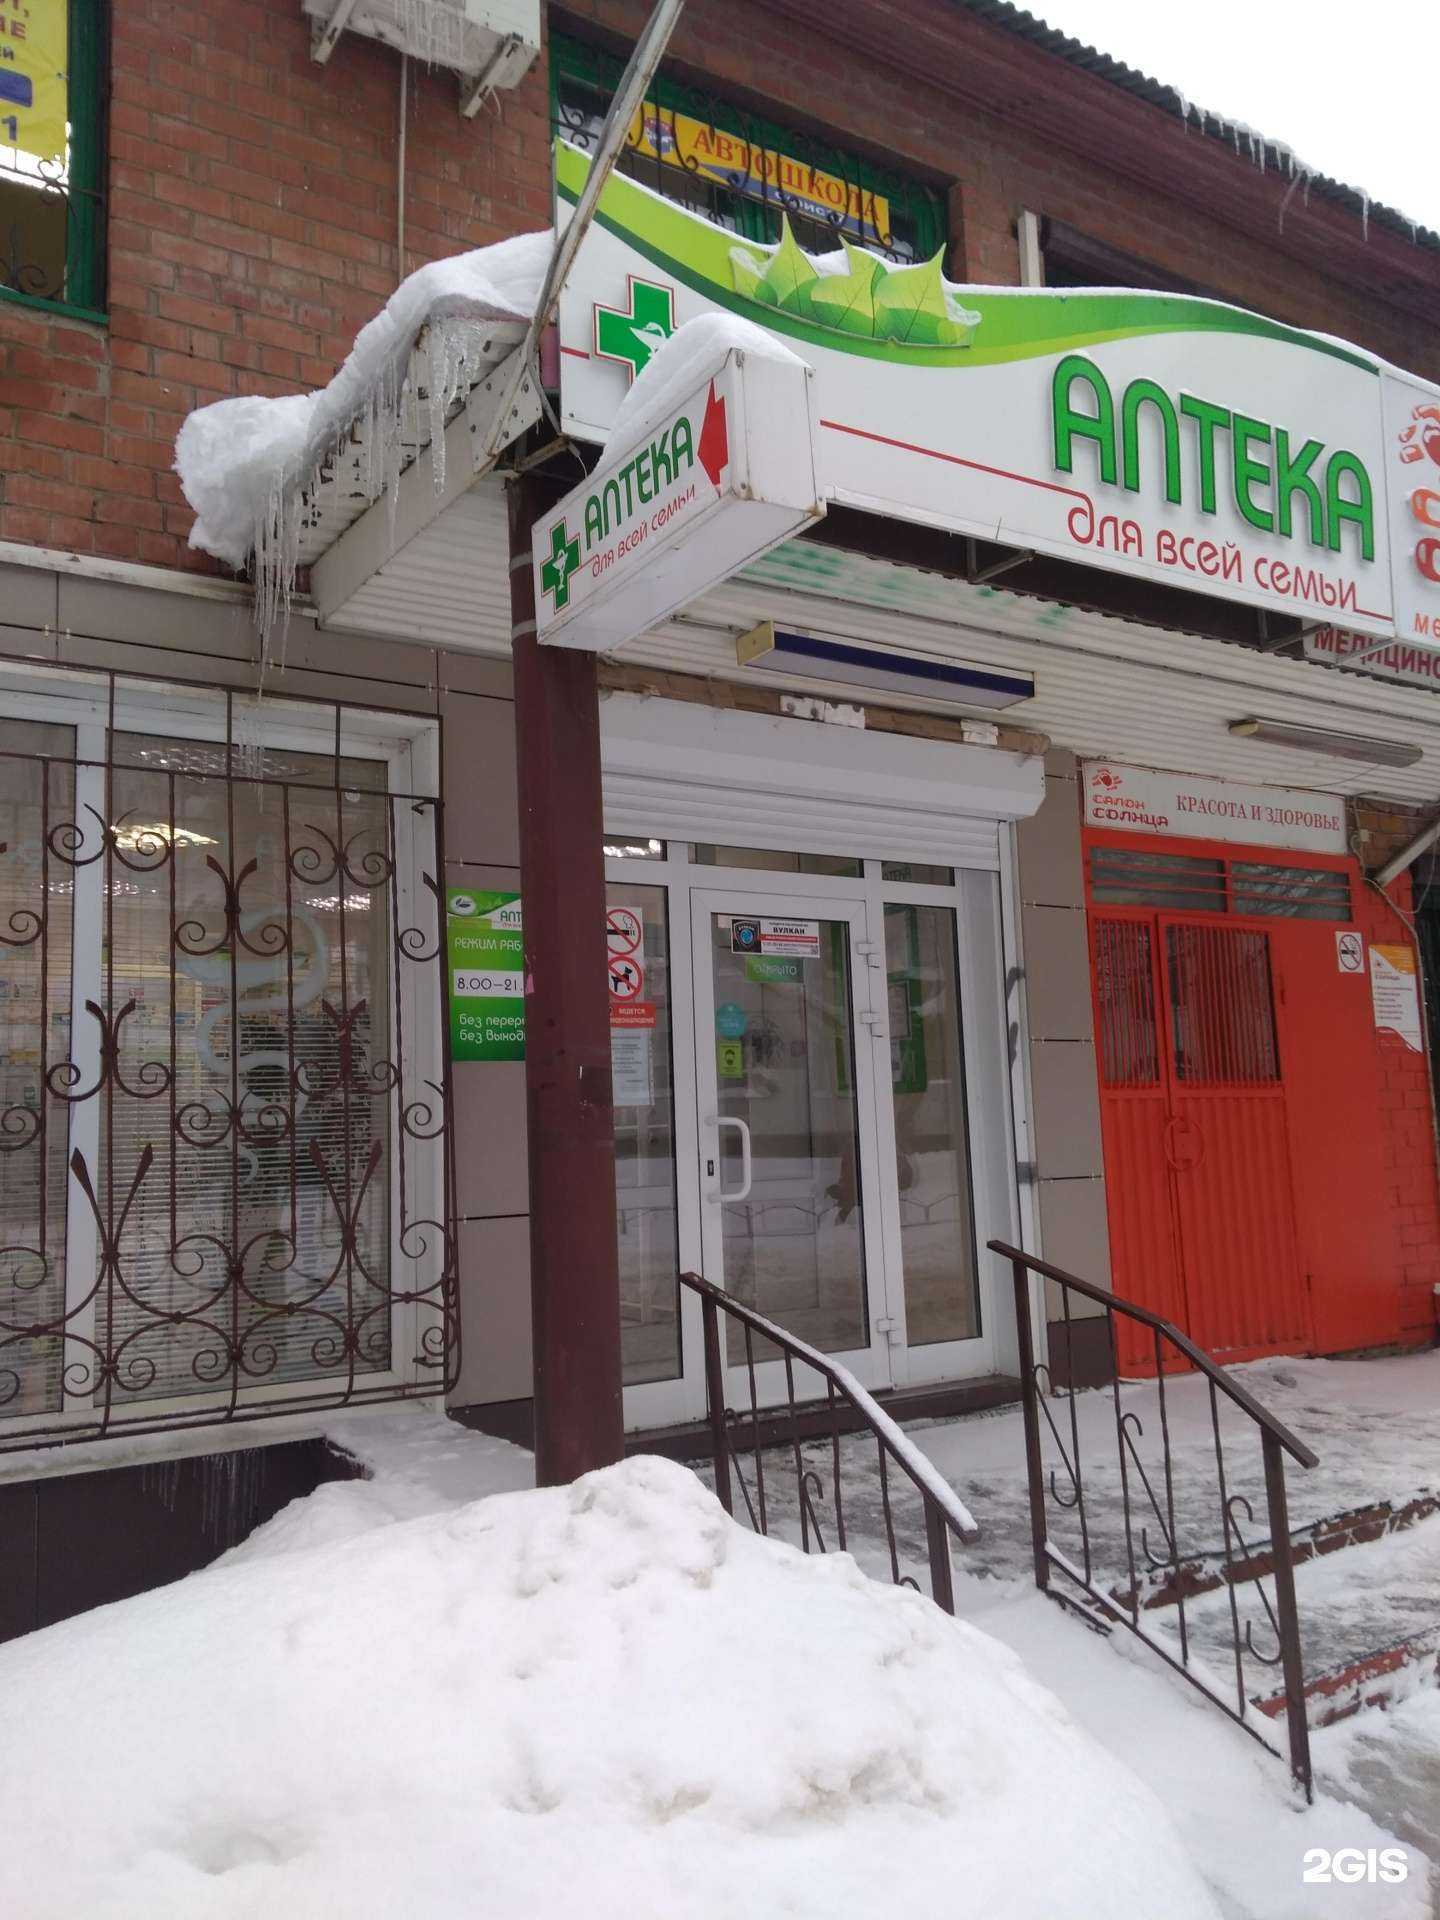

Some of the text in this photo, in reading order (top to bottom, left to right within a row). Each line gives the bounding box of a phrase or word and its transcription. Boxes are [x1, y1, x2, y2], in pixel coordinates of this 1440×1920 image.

[693, 128, 881, 222] АВТОШКОЛА
[1051, 353, 1376, 563] АПТЕКА
[583, 416, 695, 551] АПТЕКА
[592, 484, 696, 578] для всей семьи
[1067, 495, 1358, 614] для всей семьи
[1092, 794, 1145, 810] САЛОН
[1175, 794, 1341, 832] КРАСОТА И ЗДОРОВЬЕ
[1091, 807, 1169, 832] СОЛНЦА
[454, 938, 523, 952] РЕЖИМ РАБ
[772, 926, 805, 935] ВУЛКАН
[459, 1013, 482, 1029] без
[459, 1029, 483, 1045] без
